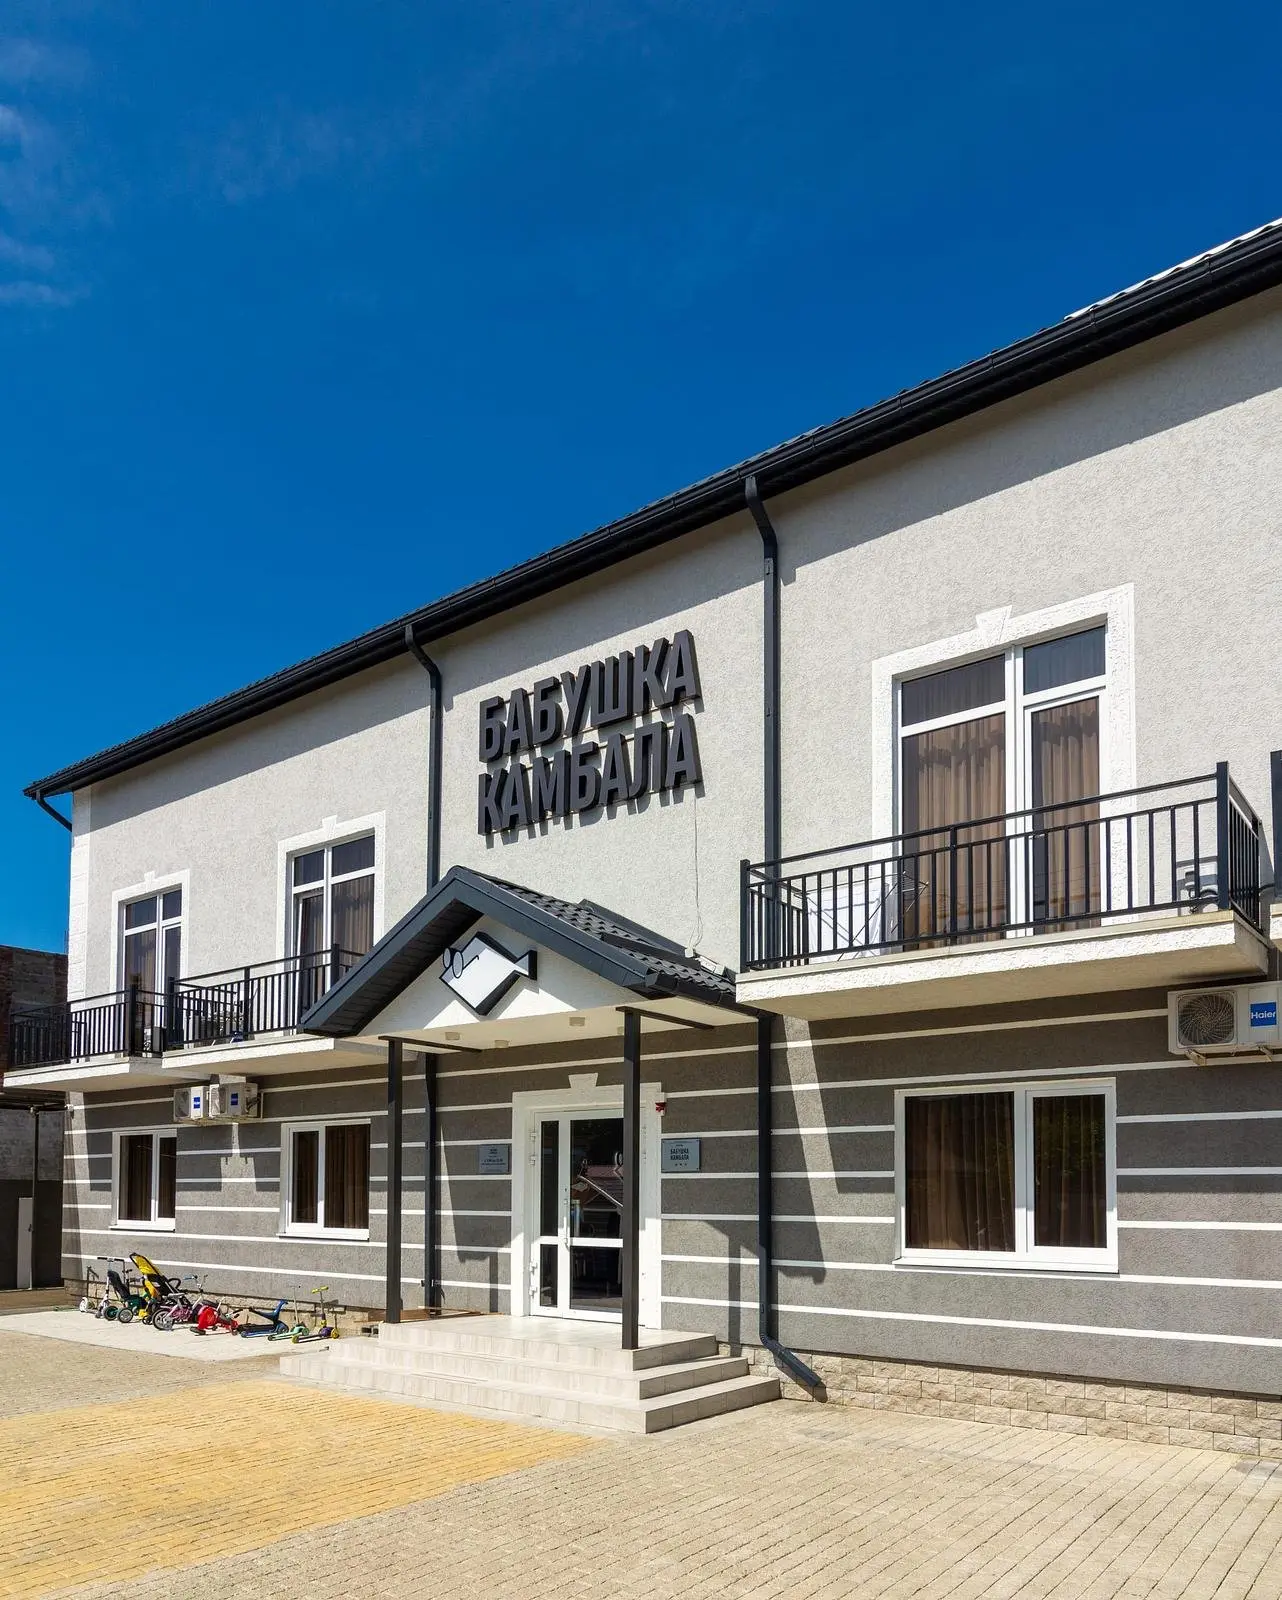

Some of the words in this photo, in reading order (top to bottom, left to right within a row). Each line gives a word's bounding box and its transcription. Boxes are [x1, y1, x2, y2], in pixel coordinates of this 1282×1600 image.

[479, 629, 702, 763] БАБУШКА
[478, 713, 703, 836] КАМБАЛА
[1251, 1010, 1276, 1019] Haier
